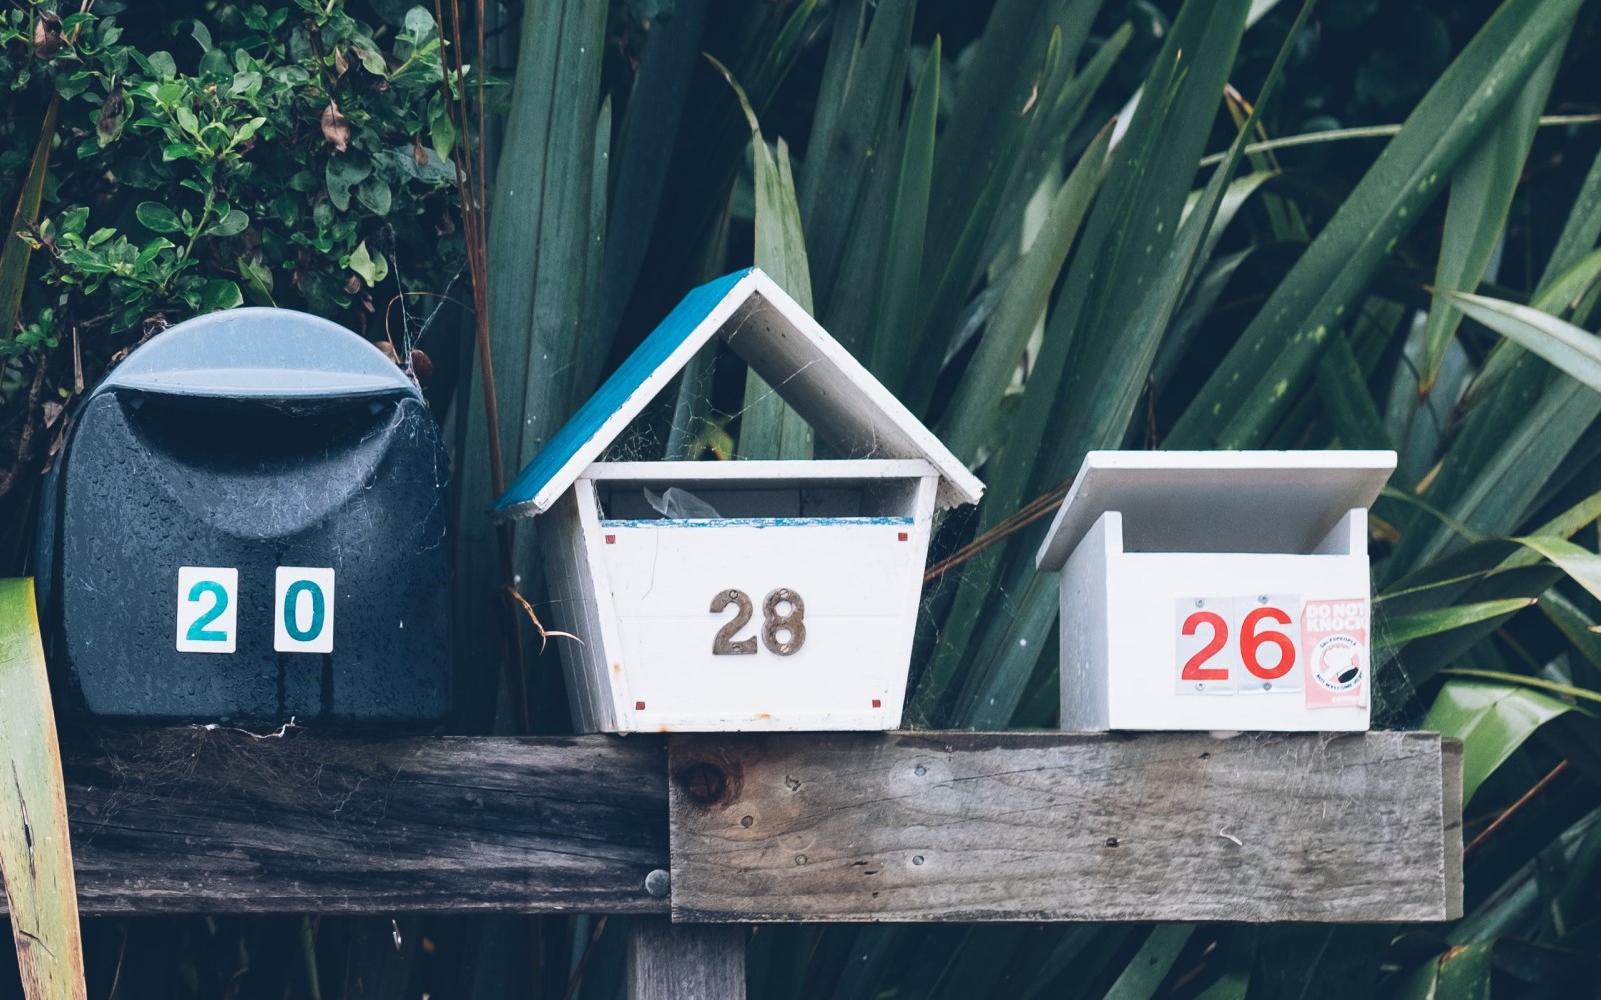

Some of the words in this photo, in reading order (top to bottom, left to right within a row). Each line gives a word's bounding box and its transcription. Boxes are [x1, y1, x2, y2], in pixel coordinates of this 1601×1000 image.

[186, 580, 326, 643] 20
[710, 588, 807, 657] 28
[1306, 604, 1331, 617] DO
[1333, 602, 1365, 617] NOT
[1306, 616, 1367, 632] KNOCK
[1181, 607, 1296, 680] 26
